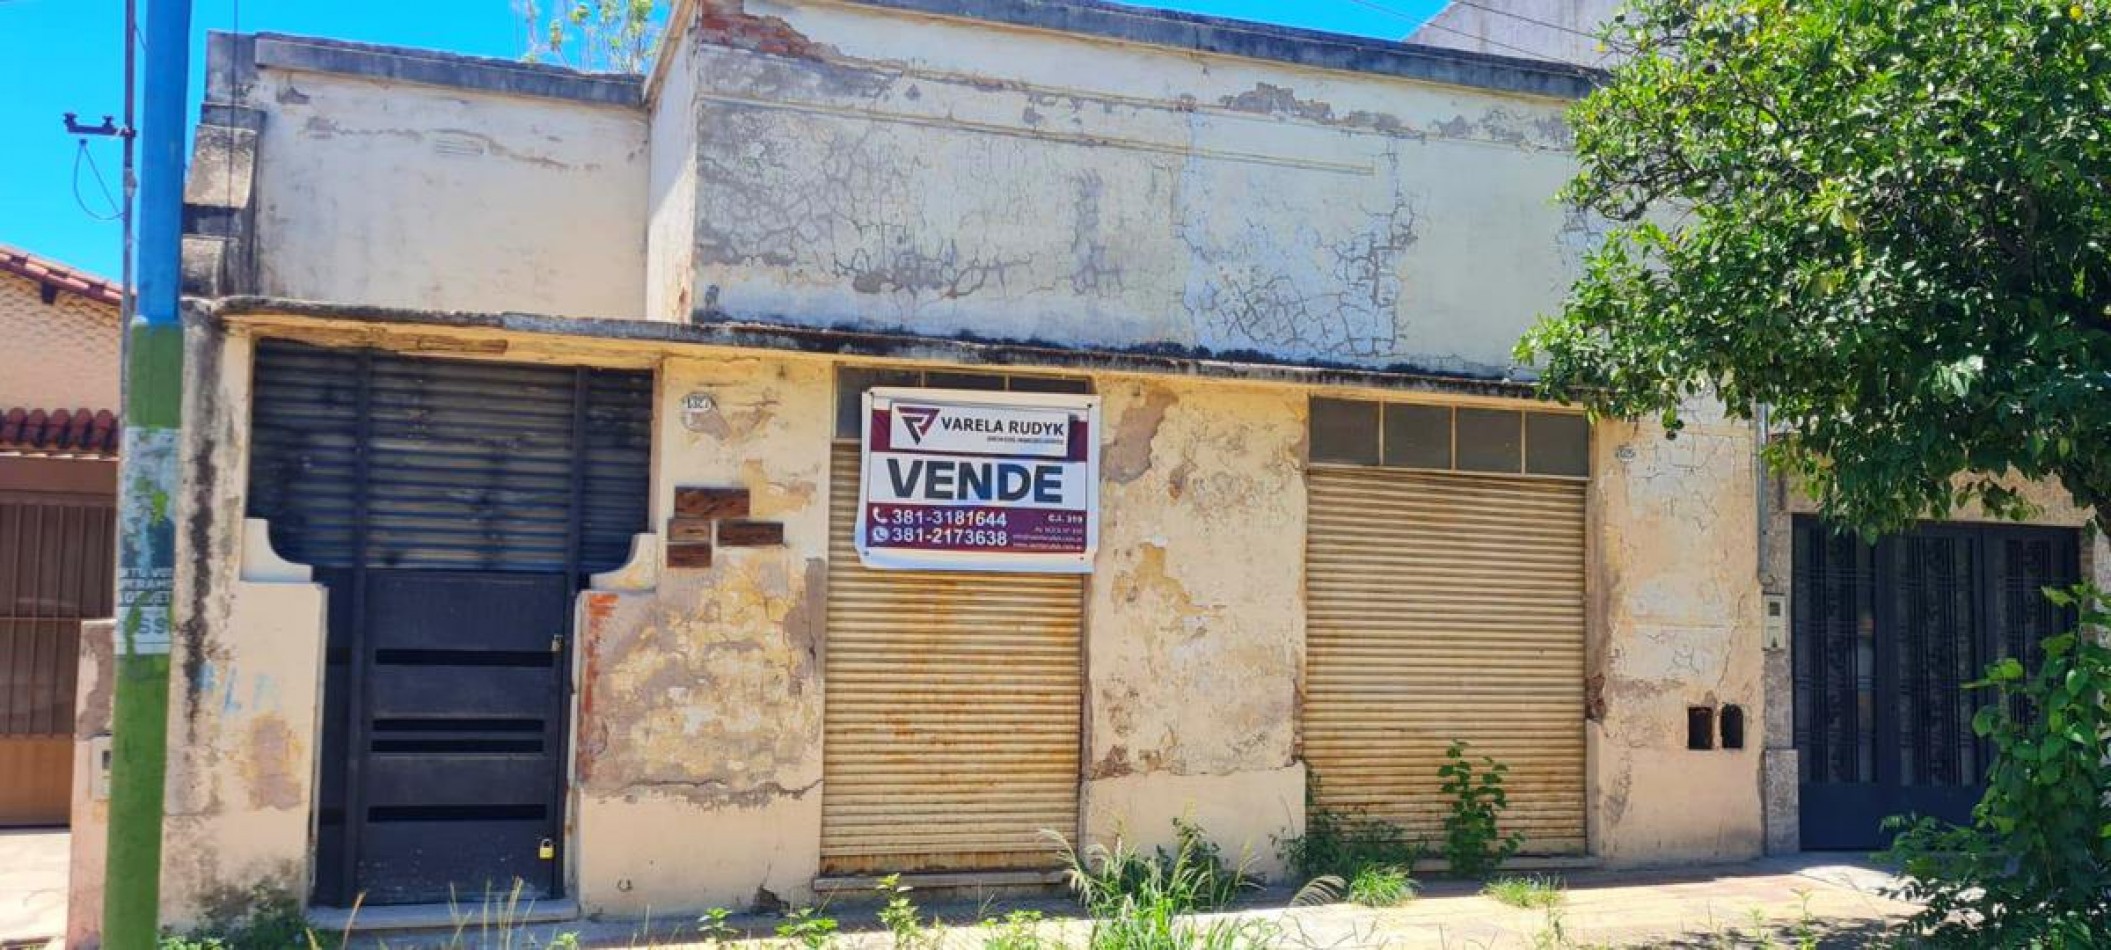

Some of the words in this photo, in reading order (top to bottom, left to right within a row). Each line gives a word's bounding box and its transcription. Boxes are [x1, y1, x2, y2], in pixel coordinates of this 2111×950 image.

[941, 416, 1004, 433] VARELA
[1008, 419, 1063, 435] RUDYK
[887, 458, 1063, 504] VENDE
[891, 509, 1008, 528] 381-3181644
[891, 527, 1008, 547] 381-2173638
